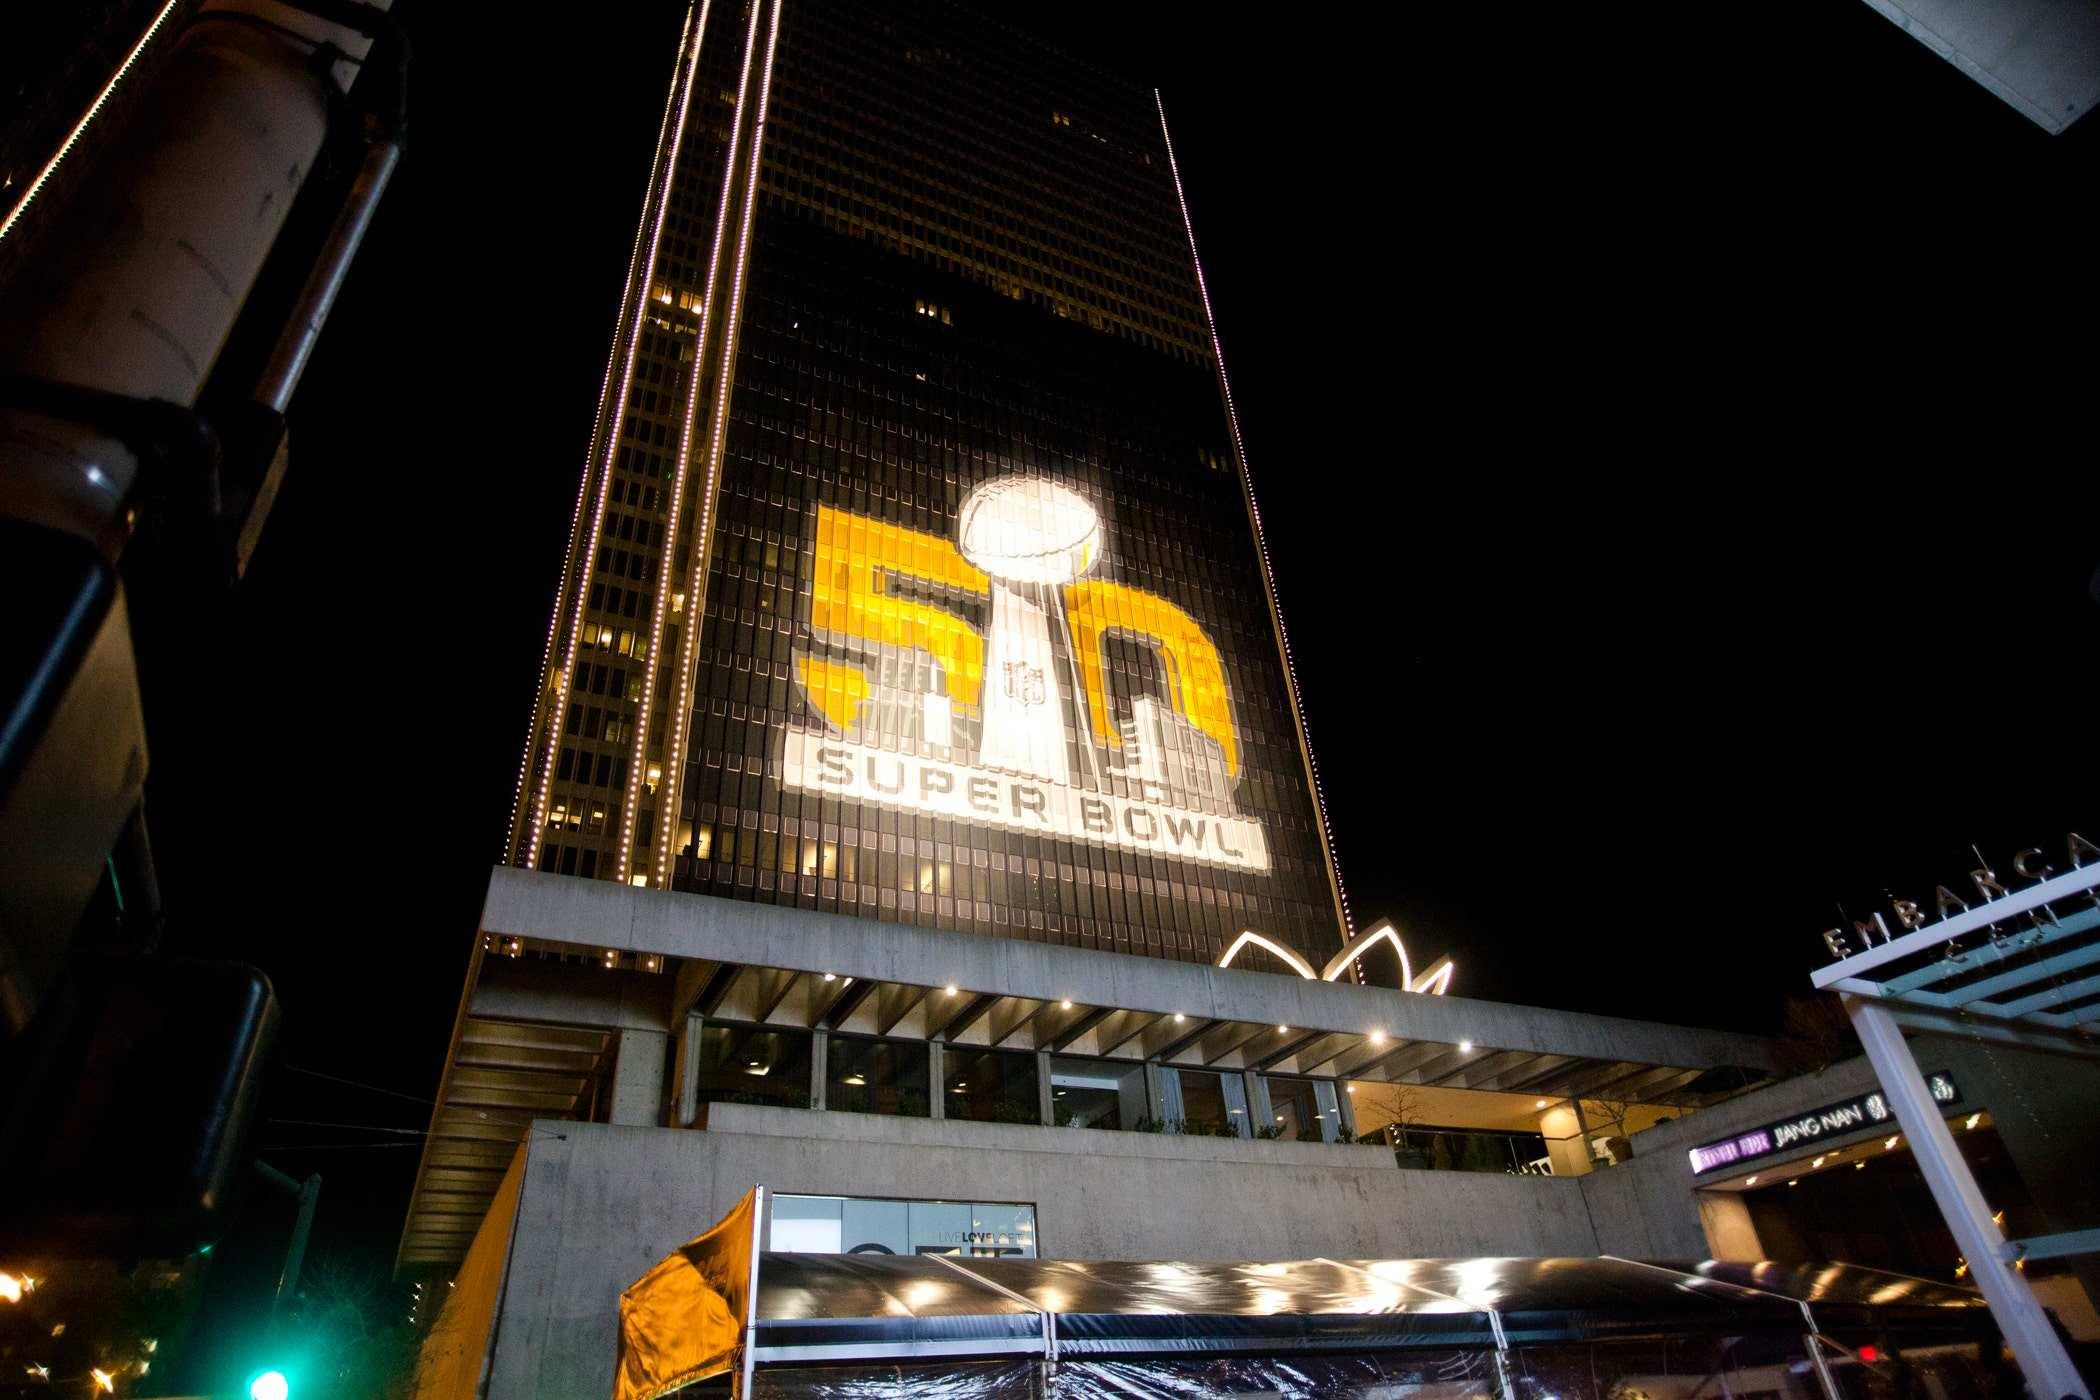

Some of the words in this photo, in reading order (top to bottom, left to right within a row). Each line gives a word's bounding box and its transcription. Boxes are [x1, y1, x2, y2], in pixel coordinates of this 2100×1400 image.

[815, 745, 1048, 824] SUPER
[1080, 791, 1244, 858] BOWL
[1773, 1119, 1821, 1148] JIANG
[1821, 1104, 1863, 1131] NAN
